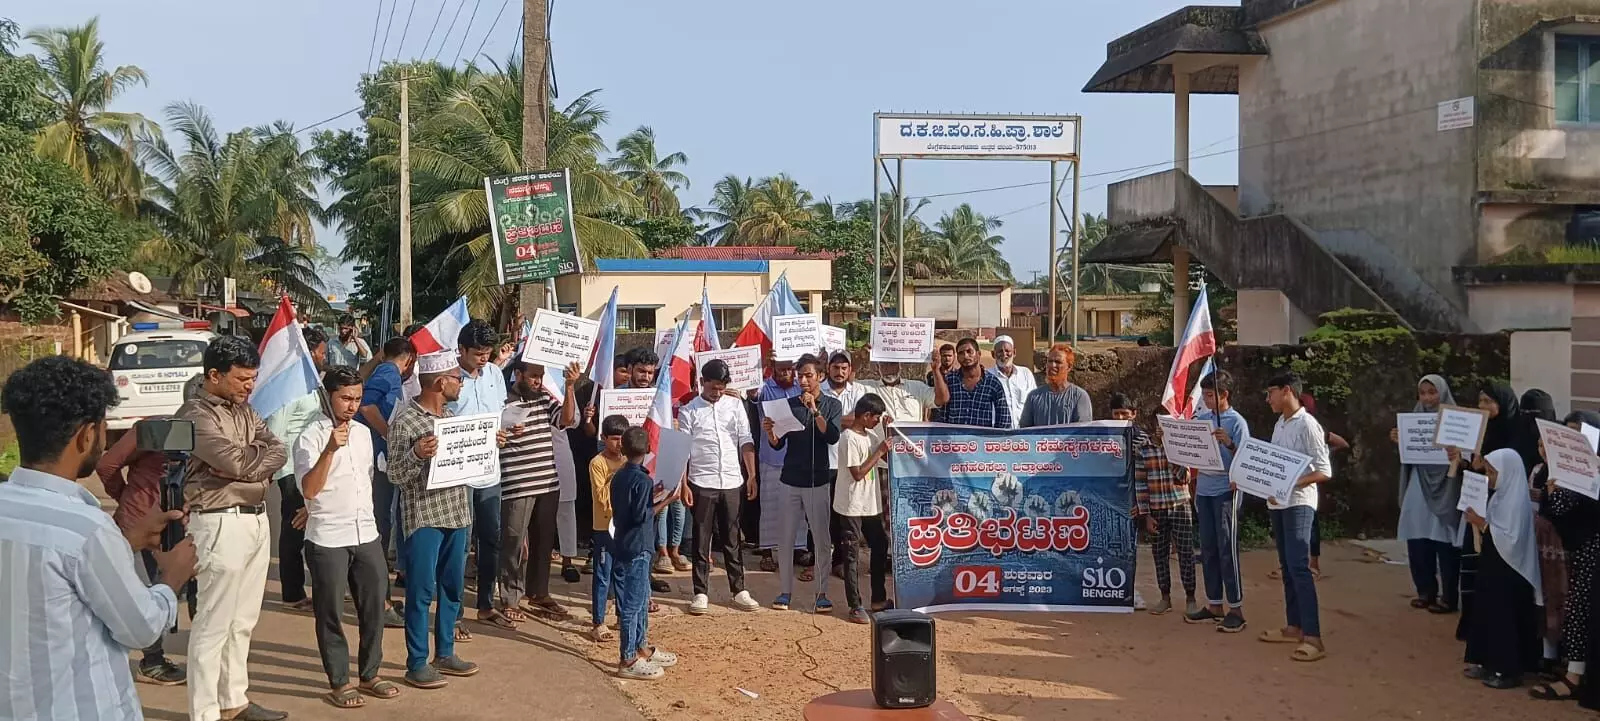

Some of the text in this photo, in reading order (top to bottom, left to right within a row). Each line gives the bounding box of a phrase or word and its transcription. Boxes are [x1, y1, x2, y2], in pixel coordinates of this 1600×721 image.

[1032, 122, 1064, 138] ಶಾಲೆ
[931, 439, 978, 454] ಸರಕಾರಿ
[984, 438, 1030, 454] ಶಾಲೆಯ
[955, 569, 1000, 593] 04
[1003, 569, 1053, 584] ಶುಕ್ರವಾರ
[1028, 585, 1053, 593] 2023
[1082, 588, 1125, 599] BENGRE
